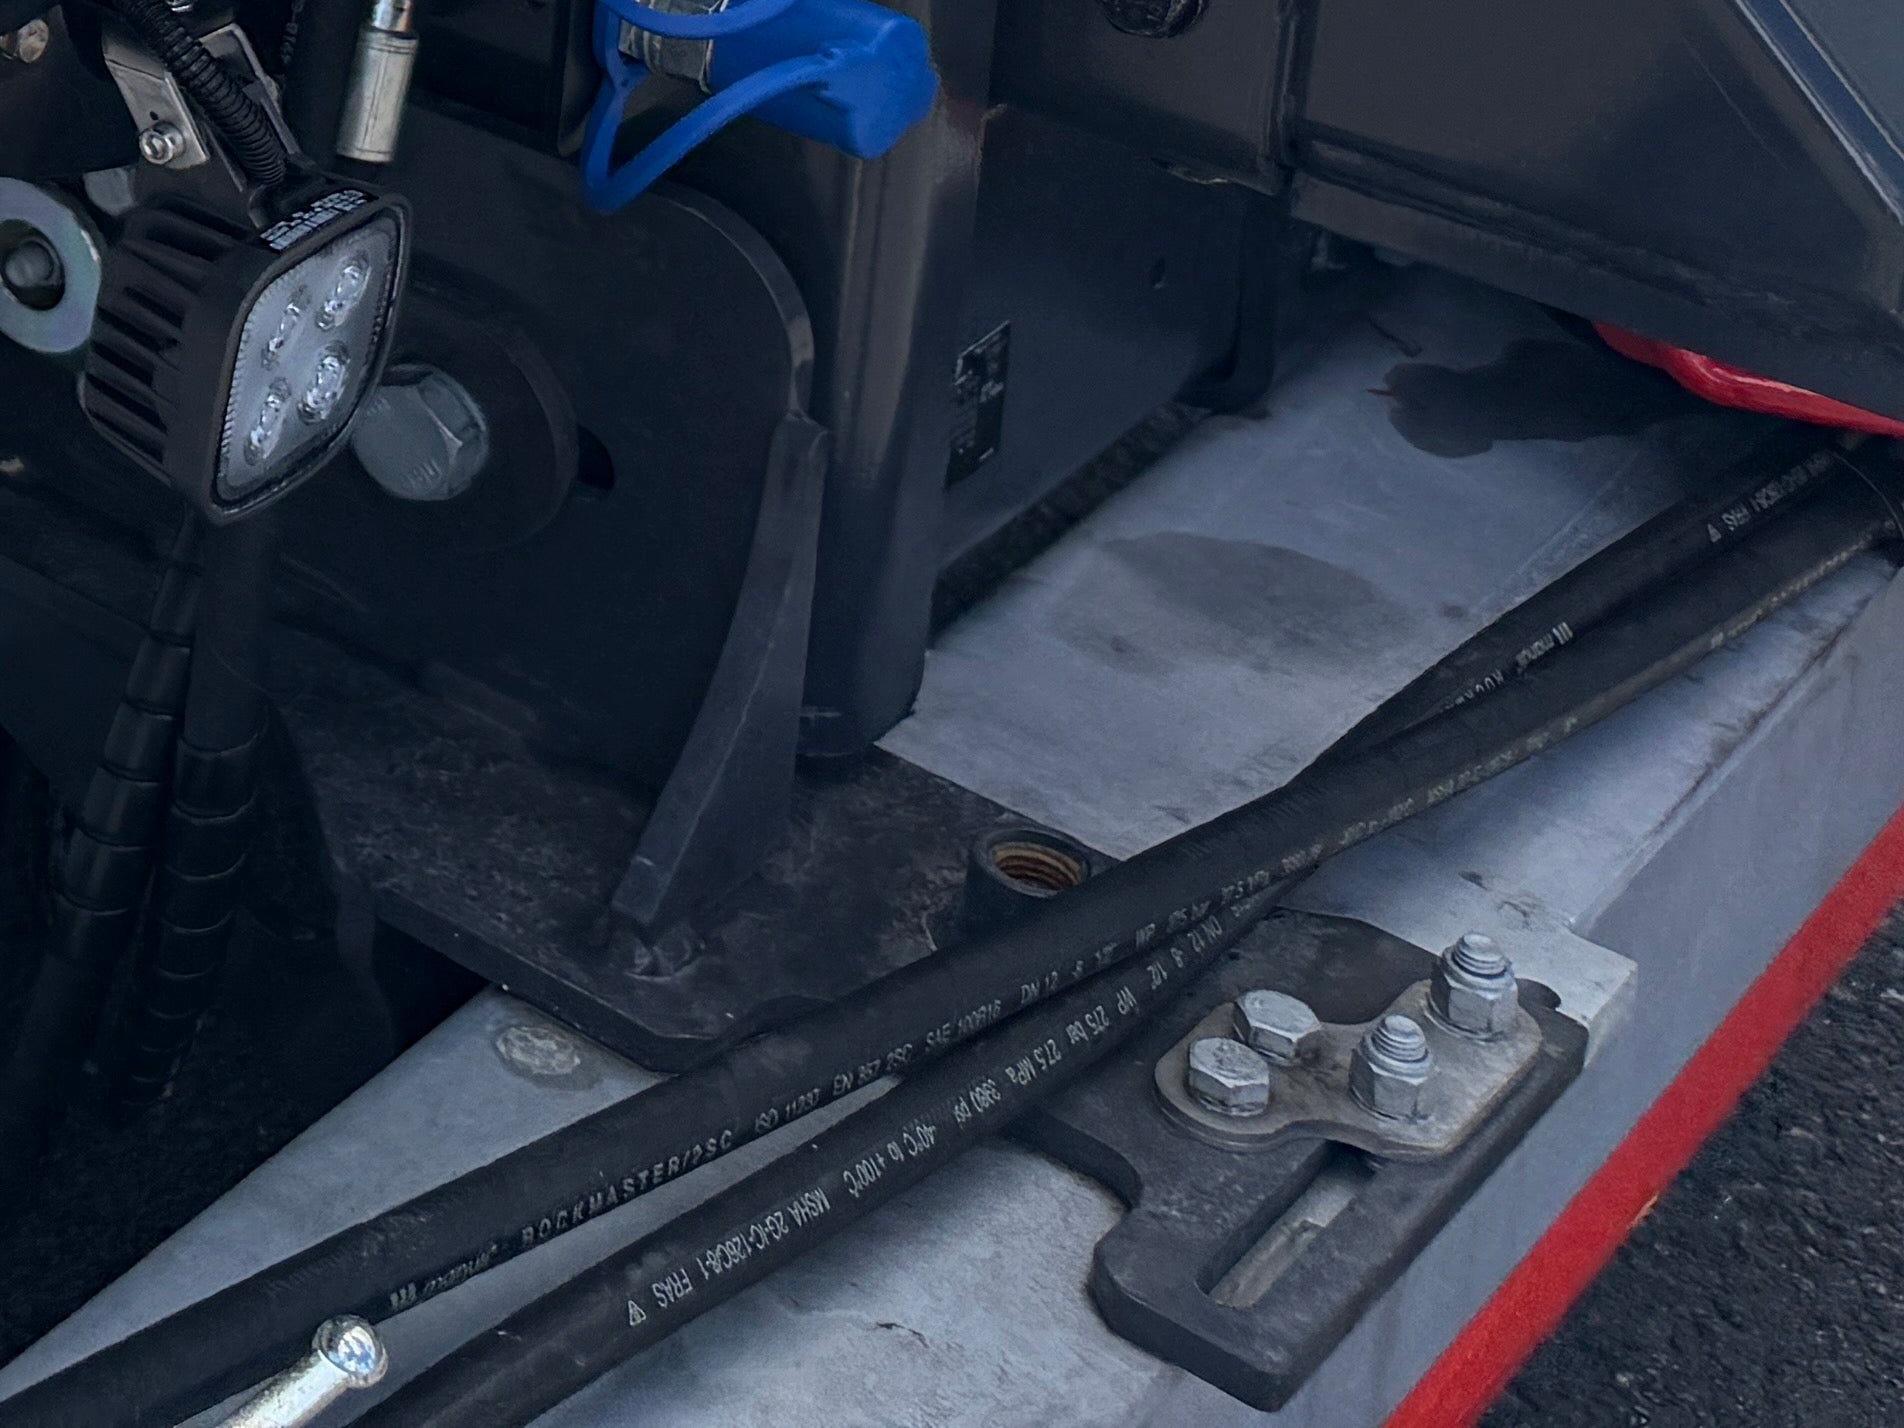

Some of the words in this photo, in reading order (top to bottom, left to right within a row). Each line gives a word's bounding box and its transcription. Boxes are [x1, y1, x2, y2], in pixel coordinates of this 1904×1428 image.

[1111, 986, 1137, 1014] WP
[1063, 1021, 1088, 1048] bar
[1082, 1005, 1111, 1035] 275
[1032, 1039, 1062, 1070] 27.5
[1004, 1055, 1037, 1087] MPa
[886, 1141, 902, 1161] to
[786, 1187, 830, 1227] MSHA
[649, 1267, 693, 1307] FRAS
